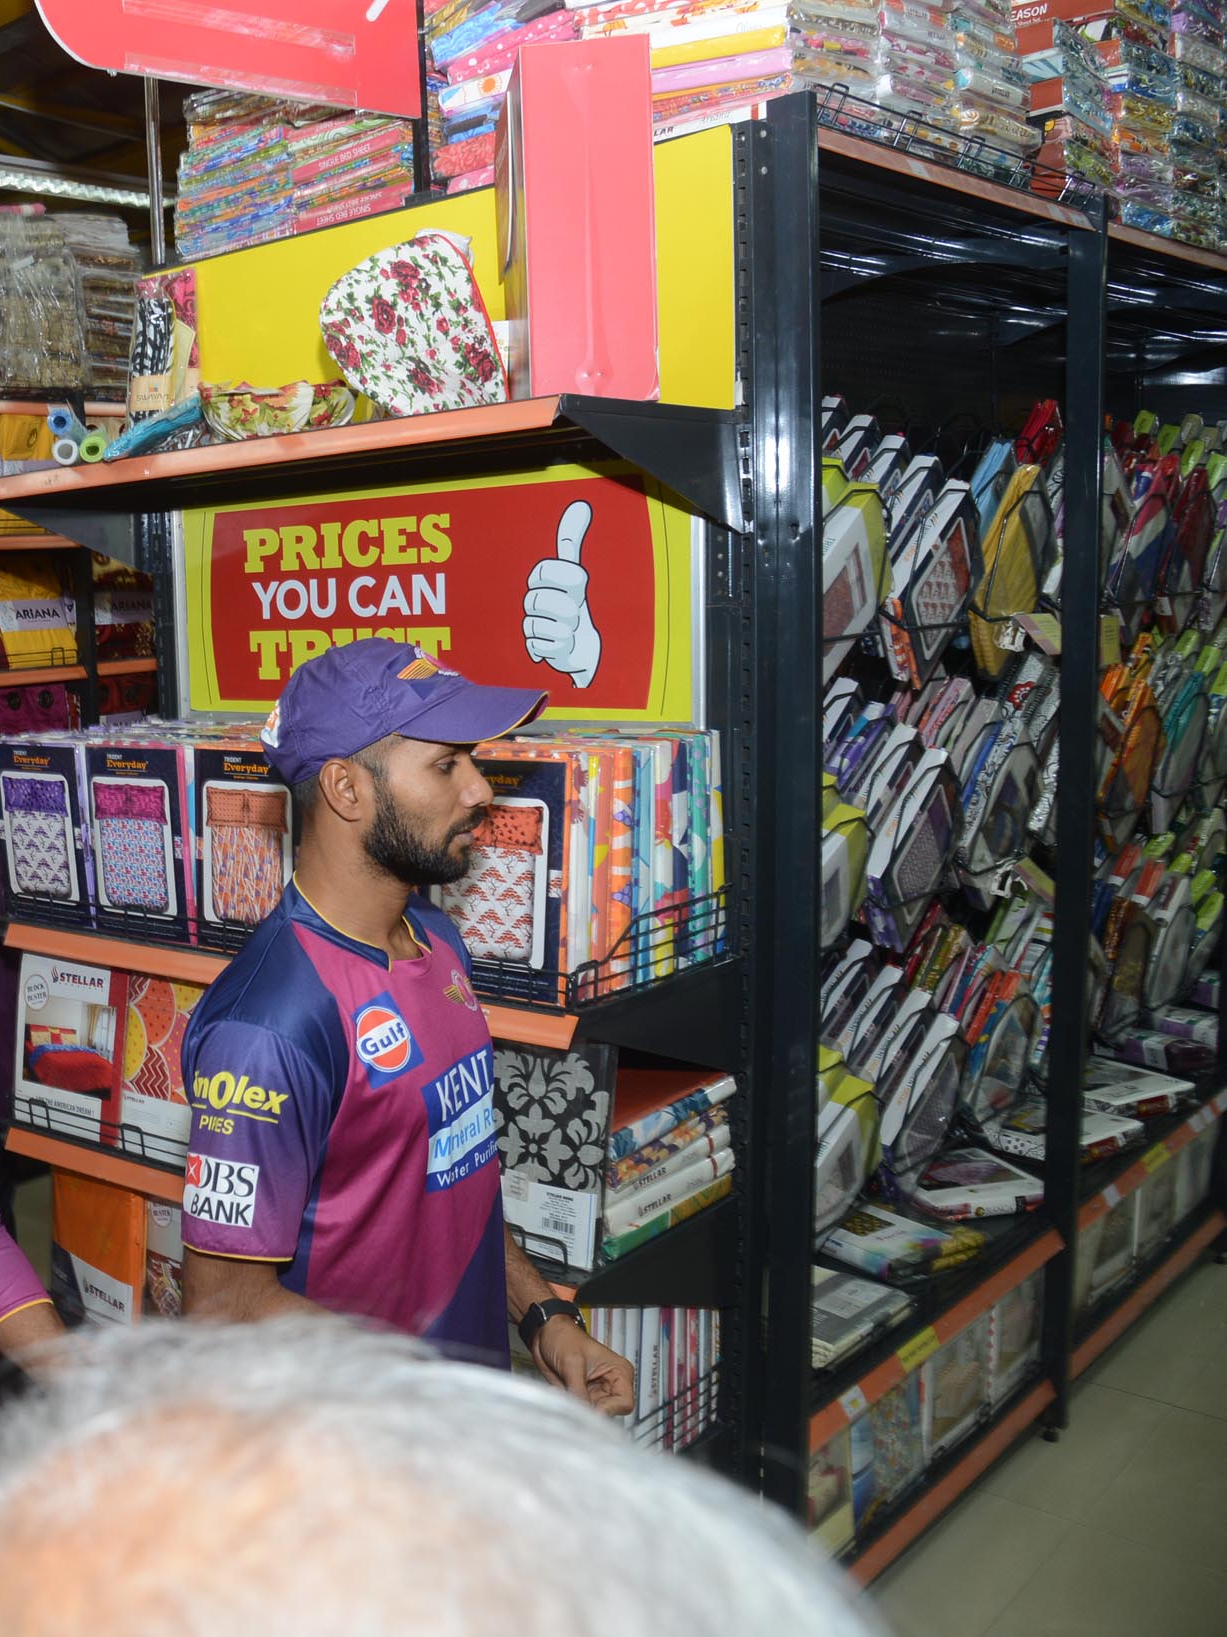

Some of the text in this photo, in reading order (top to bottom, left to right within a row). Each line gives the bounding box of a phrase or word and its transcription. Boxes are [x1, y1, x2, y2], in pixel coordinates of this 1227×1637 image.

[318, 155, 340, 171] SINGLE
[243, 513, 453, 574] PRICES
[251, 573, 446, 620] YOU CAN
[15, 608, 61, 620] ARIANA
[249, 626, 451, 681] TRT
[13, 756, 50, 766] Everyday
[106, 760, 148, 772] Everyday
[223, 762, 272, 775] Everyday
[59, 972, 104, 989] STELLAR
[360, 1021, 407, 1058] Gulf
[435, 1049, 488, 1123] KENT
[639, 1167, 667, 1187] STELLAR
[190, 1193, 253, 1227] BANK
[643, 1193, 672, 1215] STELLAR
[90, 1284, 126, 1313] STELLAR
